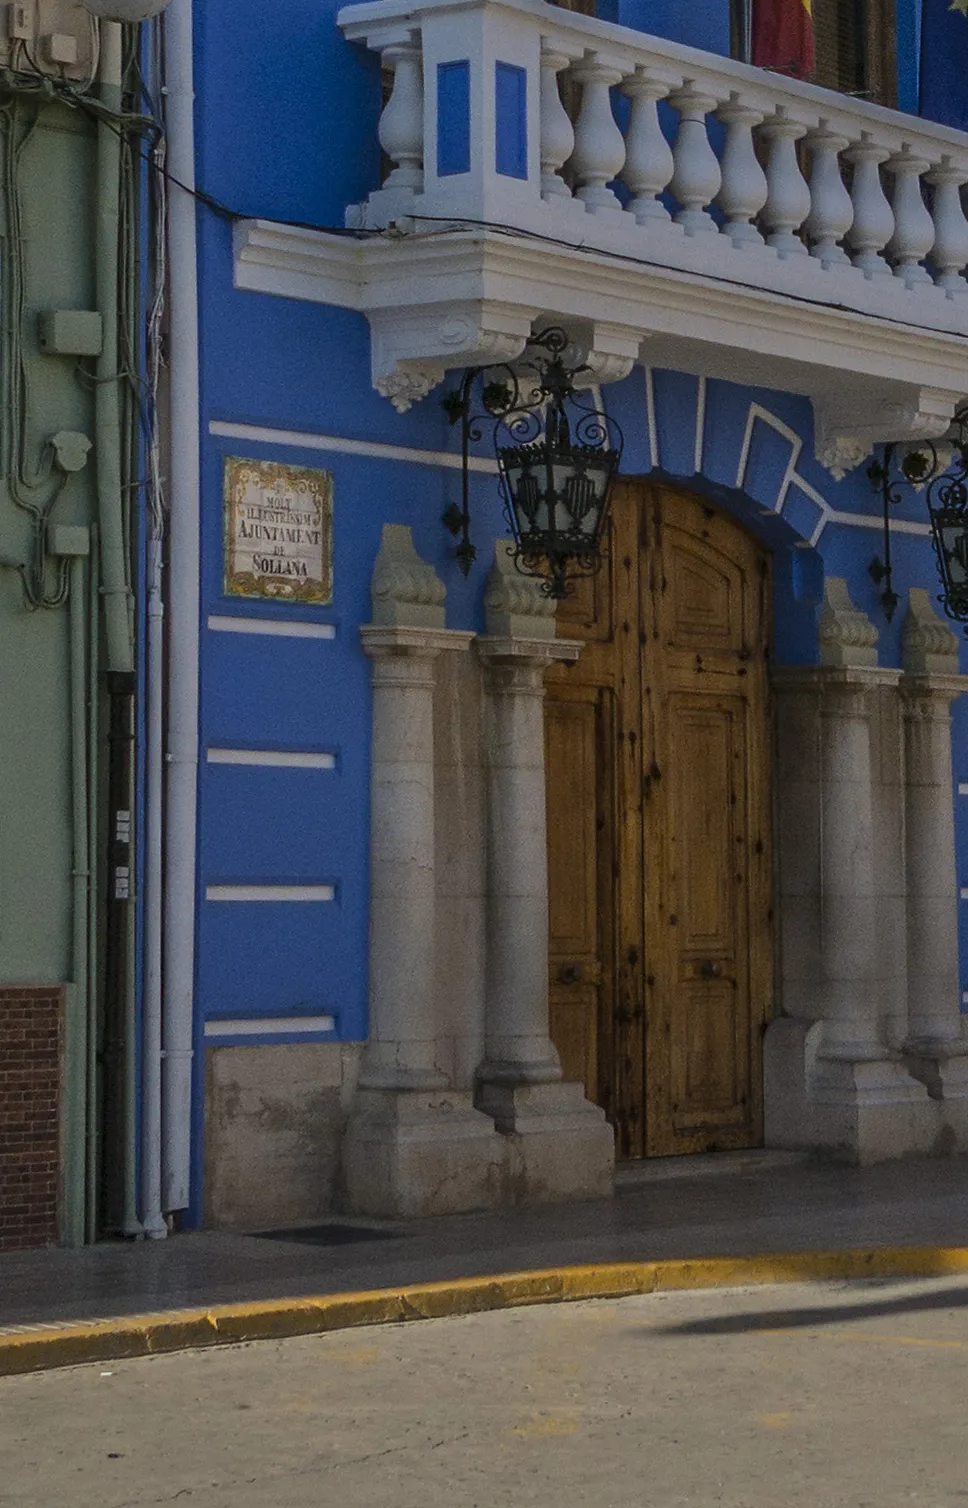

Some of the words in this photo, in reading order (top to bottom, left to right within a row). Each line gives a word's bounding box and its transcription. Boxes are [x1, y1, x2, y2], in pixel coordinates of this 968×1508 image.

[266, 496, 292, 511] MOLT
[239, 520, 320, 545] AJUNTAMENT
[273, 545, 285, 557] DE
[252, 553, 308, 576] SOLLANA
